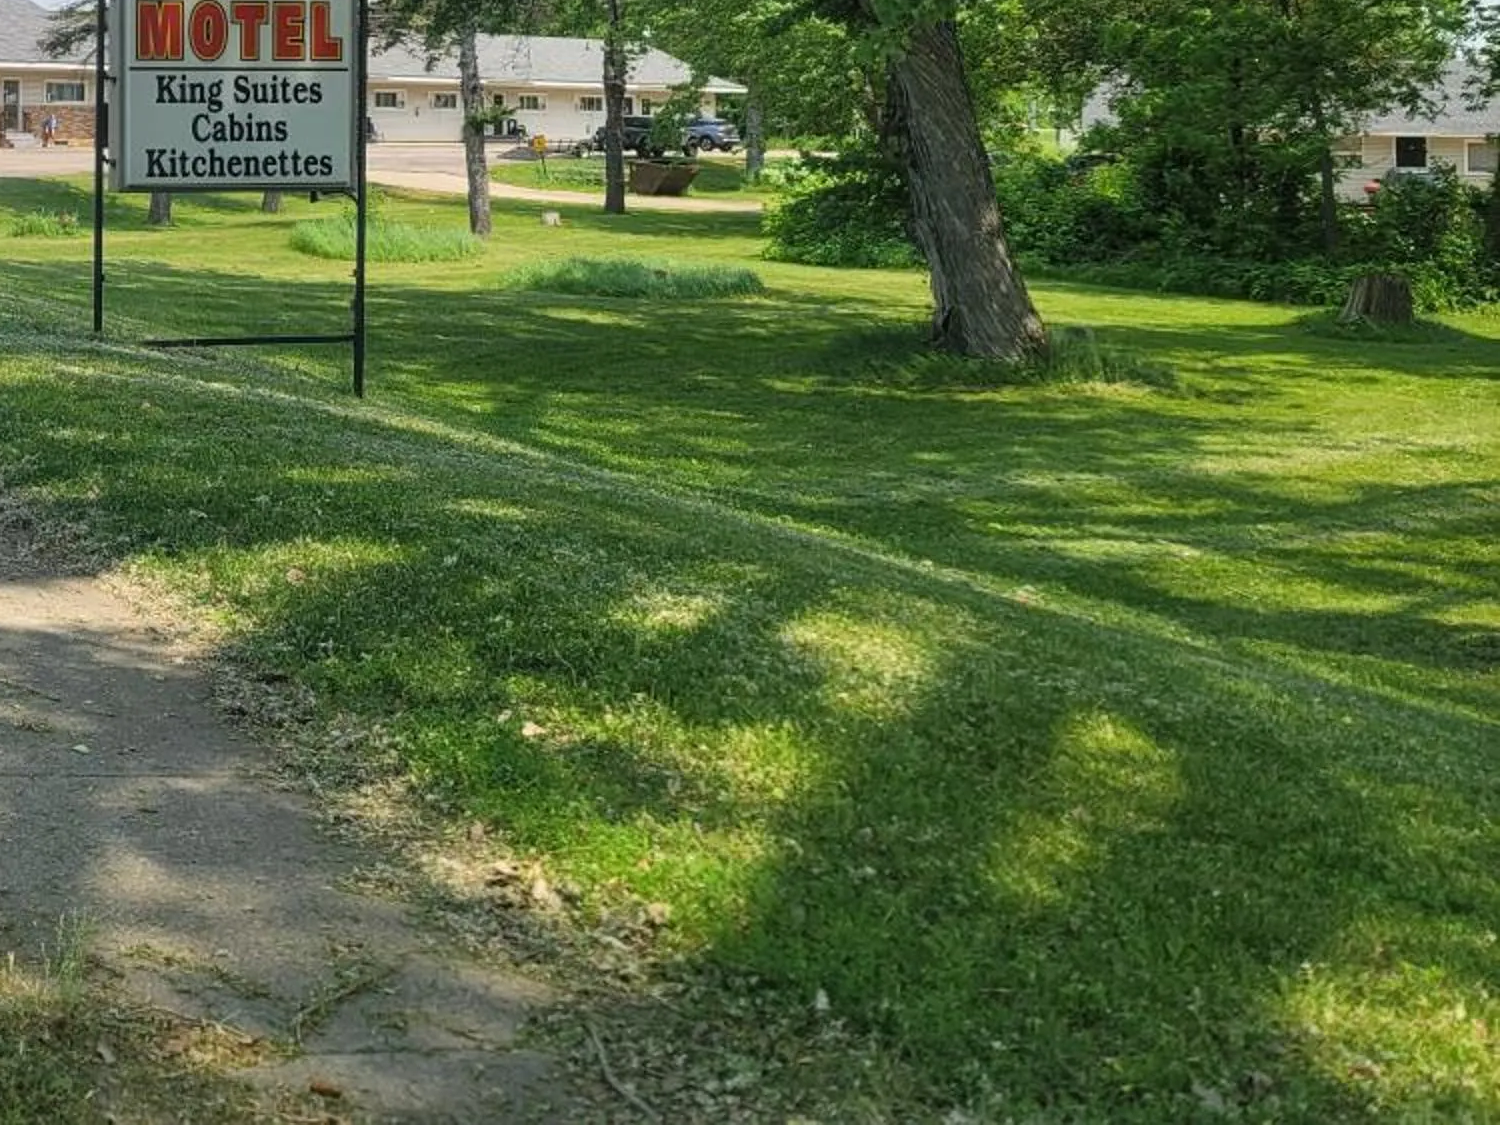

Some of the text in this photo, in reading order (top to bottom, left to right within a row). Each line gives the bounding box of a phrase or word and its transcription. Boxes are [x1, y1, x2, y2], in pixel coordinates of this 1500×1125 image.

[155, 75, 323, 113] King Suites
[191, 113, 288, 142] Cabins
[145, 148, 333, 178] Kitchenettes
